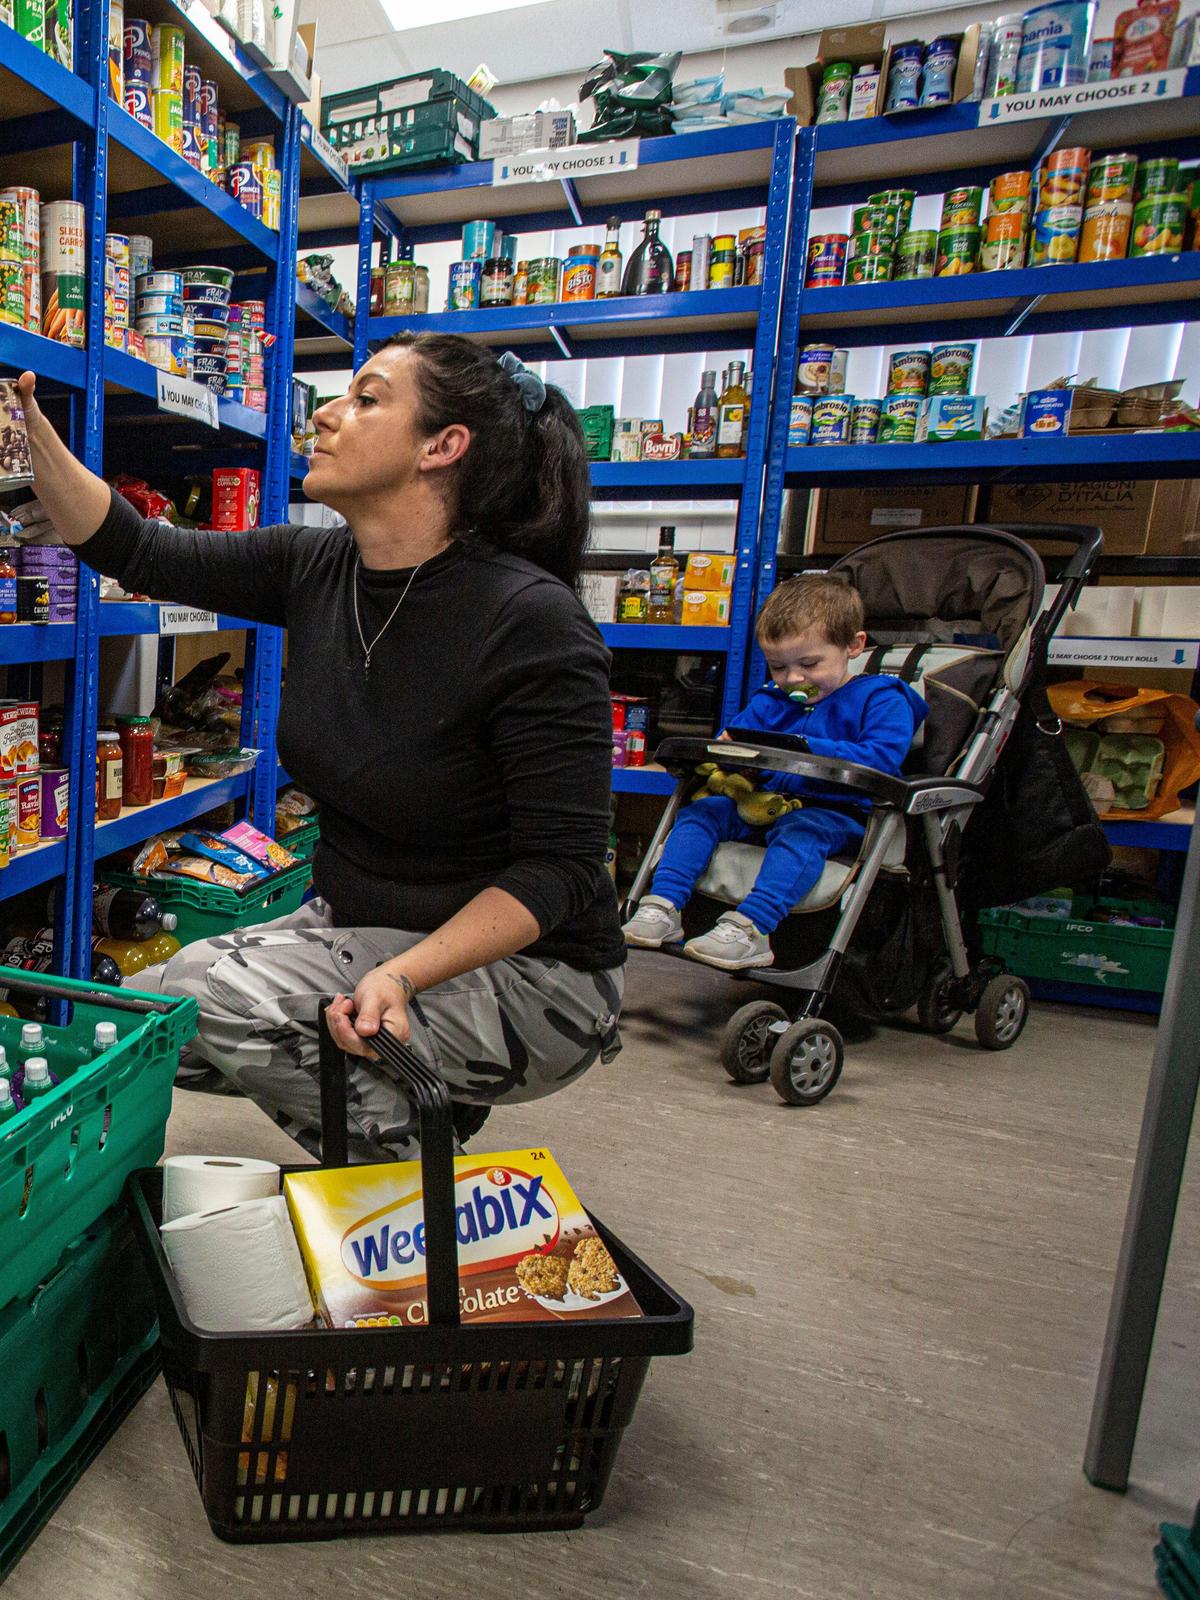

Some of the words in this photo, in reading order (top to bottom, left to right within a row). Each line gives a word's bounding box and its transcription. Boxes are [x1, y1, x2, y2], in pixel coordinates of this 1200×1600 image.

[1006, 99, 1035, 112] YOU
[1040, 95, 1071, 108] MAY
[1076, 85, 1136, 103] CHOOSE
[1142, 82, 1150, 93] 2
[513, 166, 534, 176] YOU
[562, 156, 605, 170] CHOOSE
[609, 155, 614, 164] 1
[206, 288, 224, 297] FRAY
[197, 358, 217, 367] FRAY
[208, 376, 224, 385] FRAY
[166, 389, 181, 402] YOU
[181, 396, 195, 407] MAY
[645, 439, 676, 453] Bovril
[167, 613, 177, 622] YOU
[178, 613, 189, 622] MAY
[1066, 923, 1094, 934] IFCO
[530, 1151, 547, 1161] 24
[351, 1176, 552, 1277] Weeabix
[406, 1286, 520, 1324] Colate
